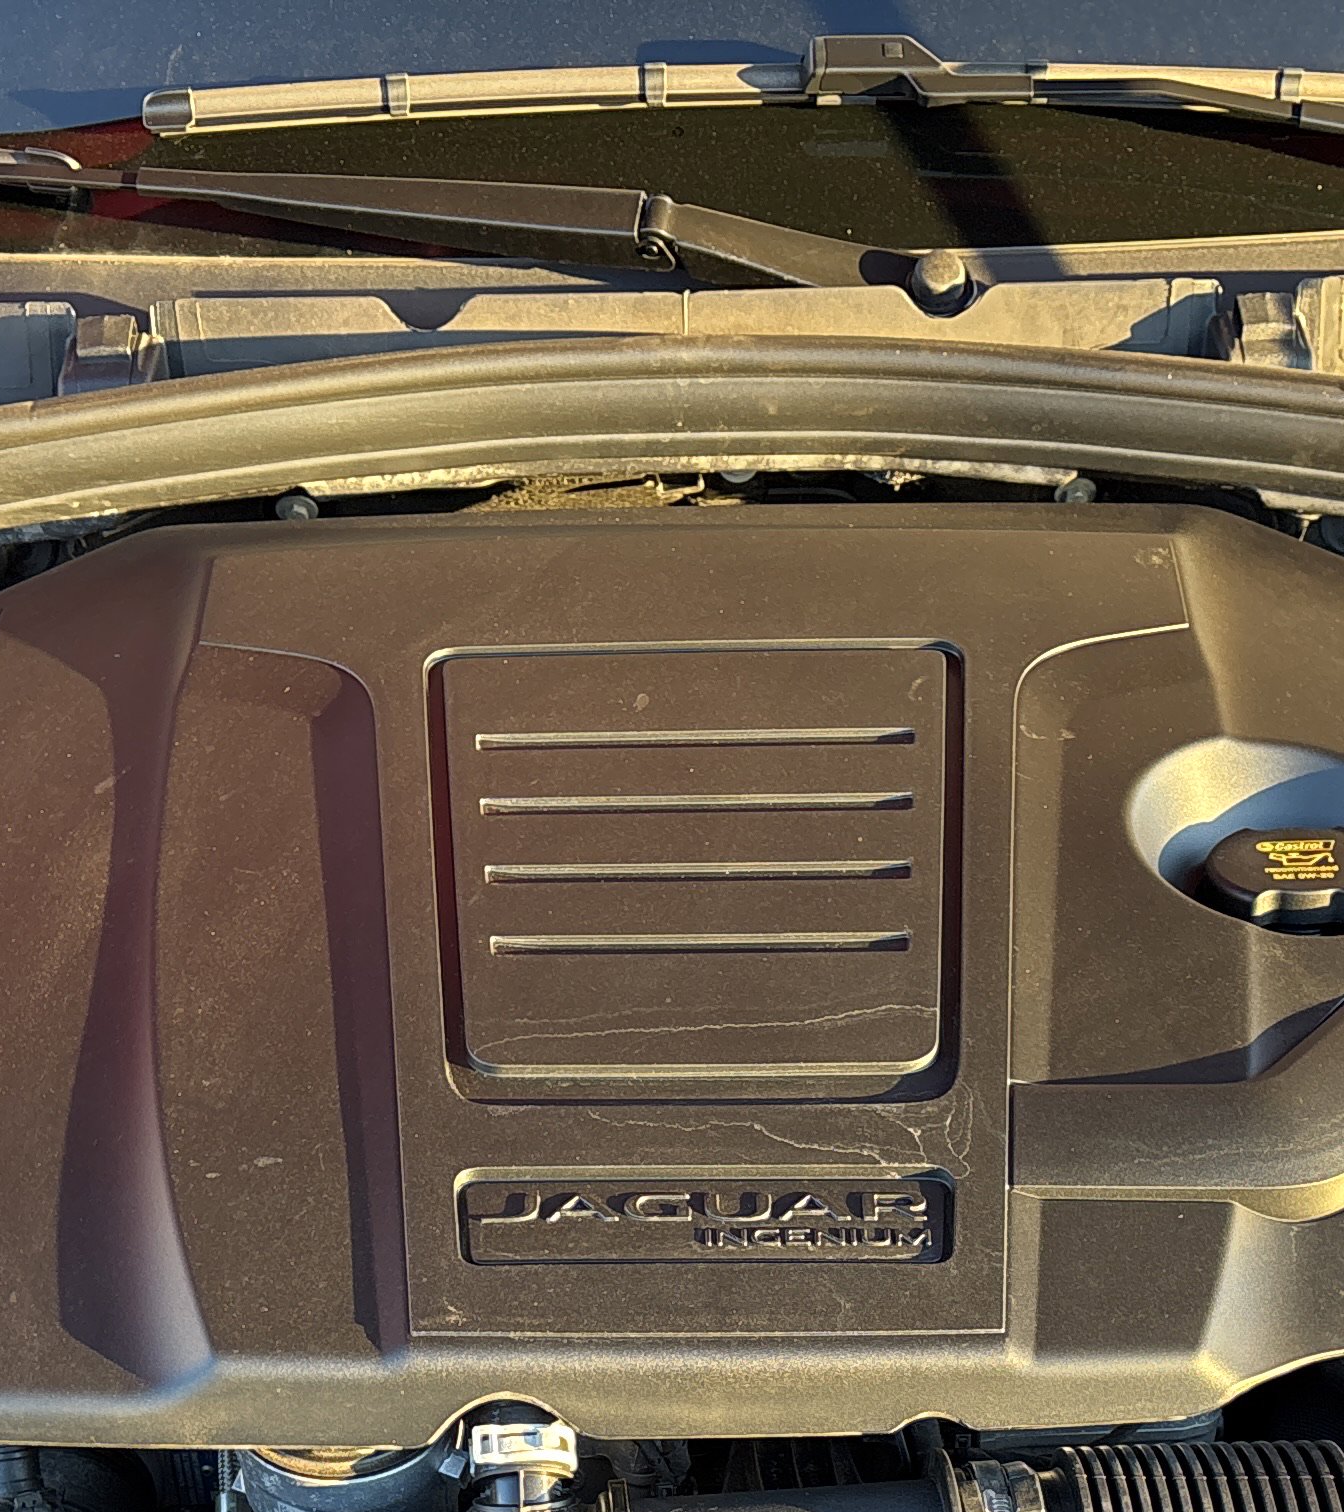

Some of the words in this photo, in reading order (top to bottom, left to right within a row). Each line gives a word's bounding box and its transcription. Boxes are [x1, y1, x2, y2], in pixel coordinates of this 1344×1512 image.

[1275, 841, 1324, 851] Castrol
[1264, 864, 1340, 873] recommended
[480, 1190, 928, 1226] JAGUAR
[700, 1226, 934, 1249] INGENIUM
